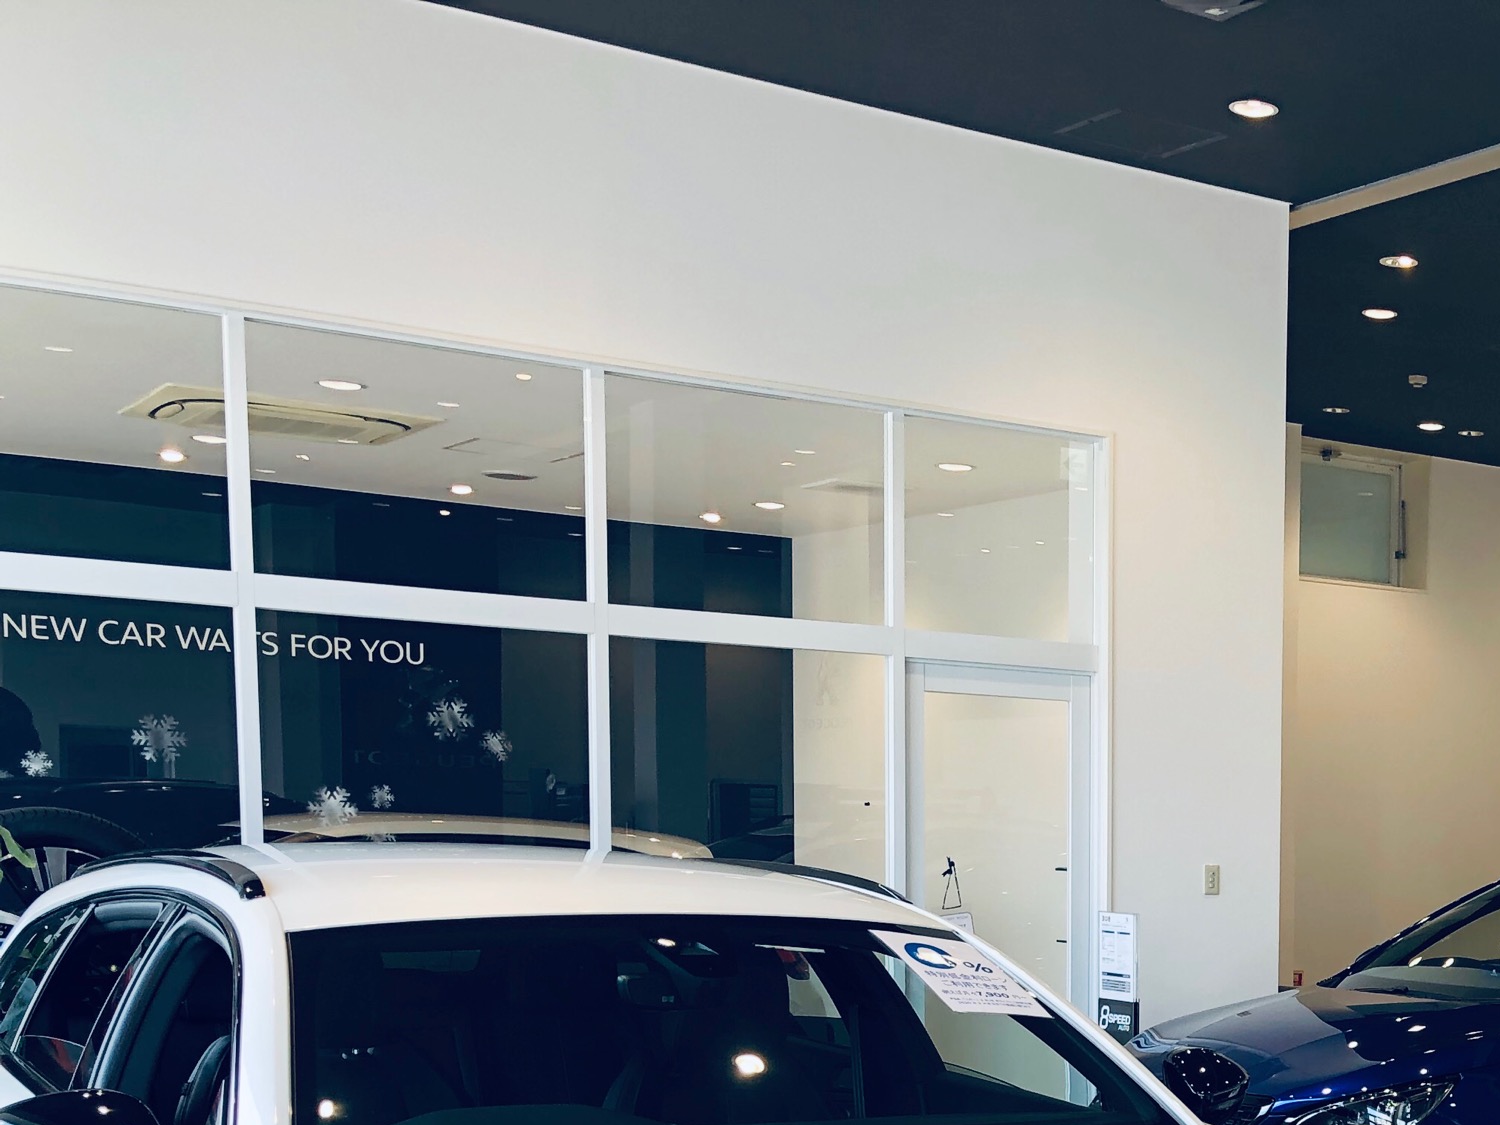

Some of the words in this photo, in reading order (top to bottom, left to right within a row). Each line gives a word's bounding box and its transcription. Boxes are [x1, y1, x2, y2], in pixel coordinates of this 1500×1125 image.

[2, 613, 87, 642] NEW
[98, 619, 167, 649] CAR
[175, 624, 279, 656] WAS
[290, 633, 352, 661] FOR
[360, 638, 425, 666] YOU
[1109, 1011, 1131, 1026] SPEED
